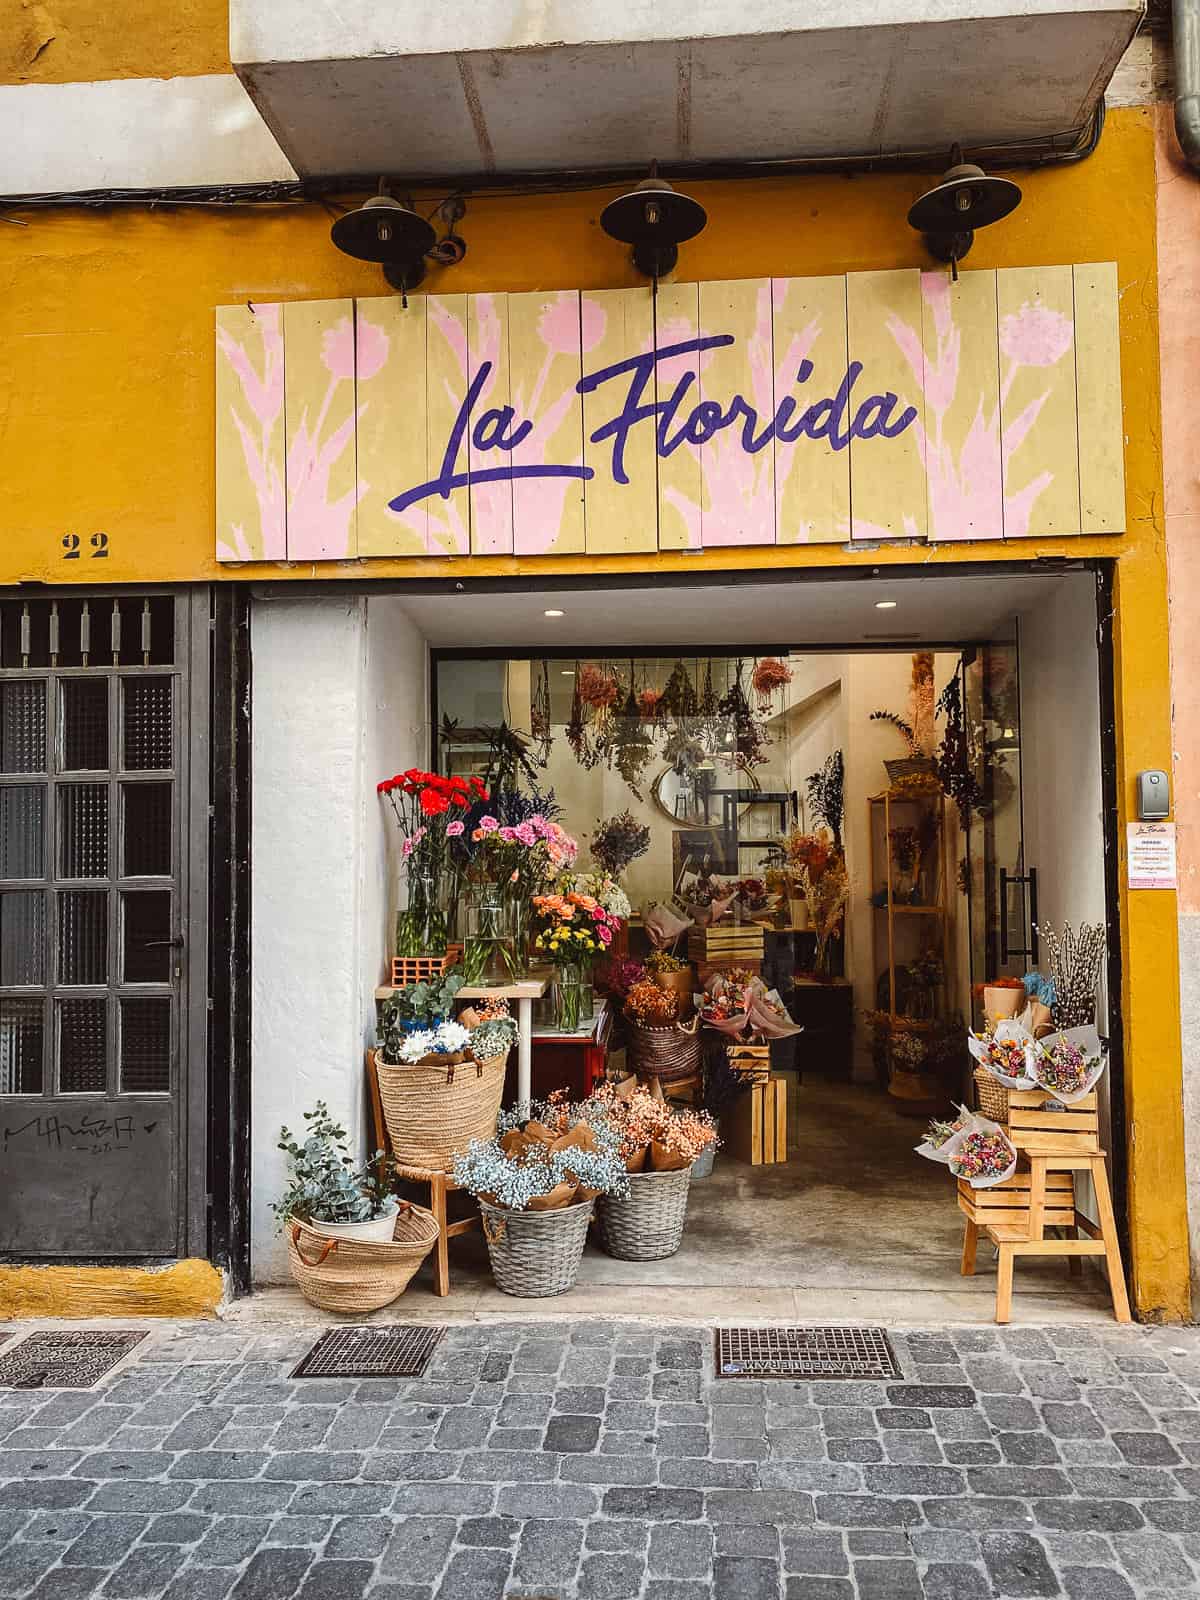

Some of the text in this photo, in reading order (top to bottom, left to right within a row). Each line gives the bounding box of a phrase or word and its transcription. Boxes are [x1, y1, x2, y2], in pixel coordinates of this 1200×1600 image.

[388, 335, 917, 512] La Florida
[62, 532, 108, 559] 22
